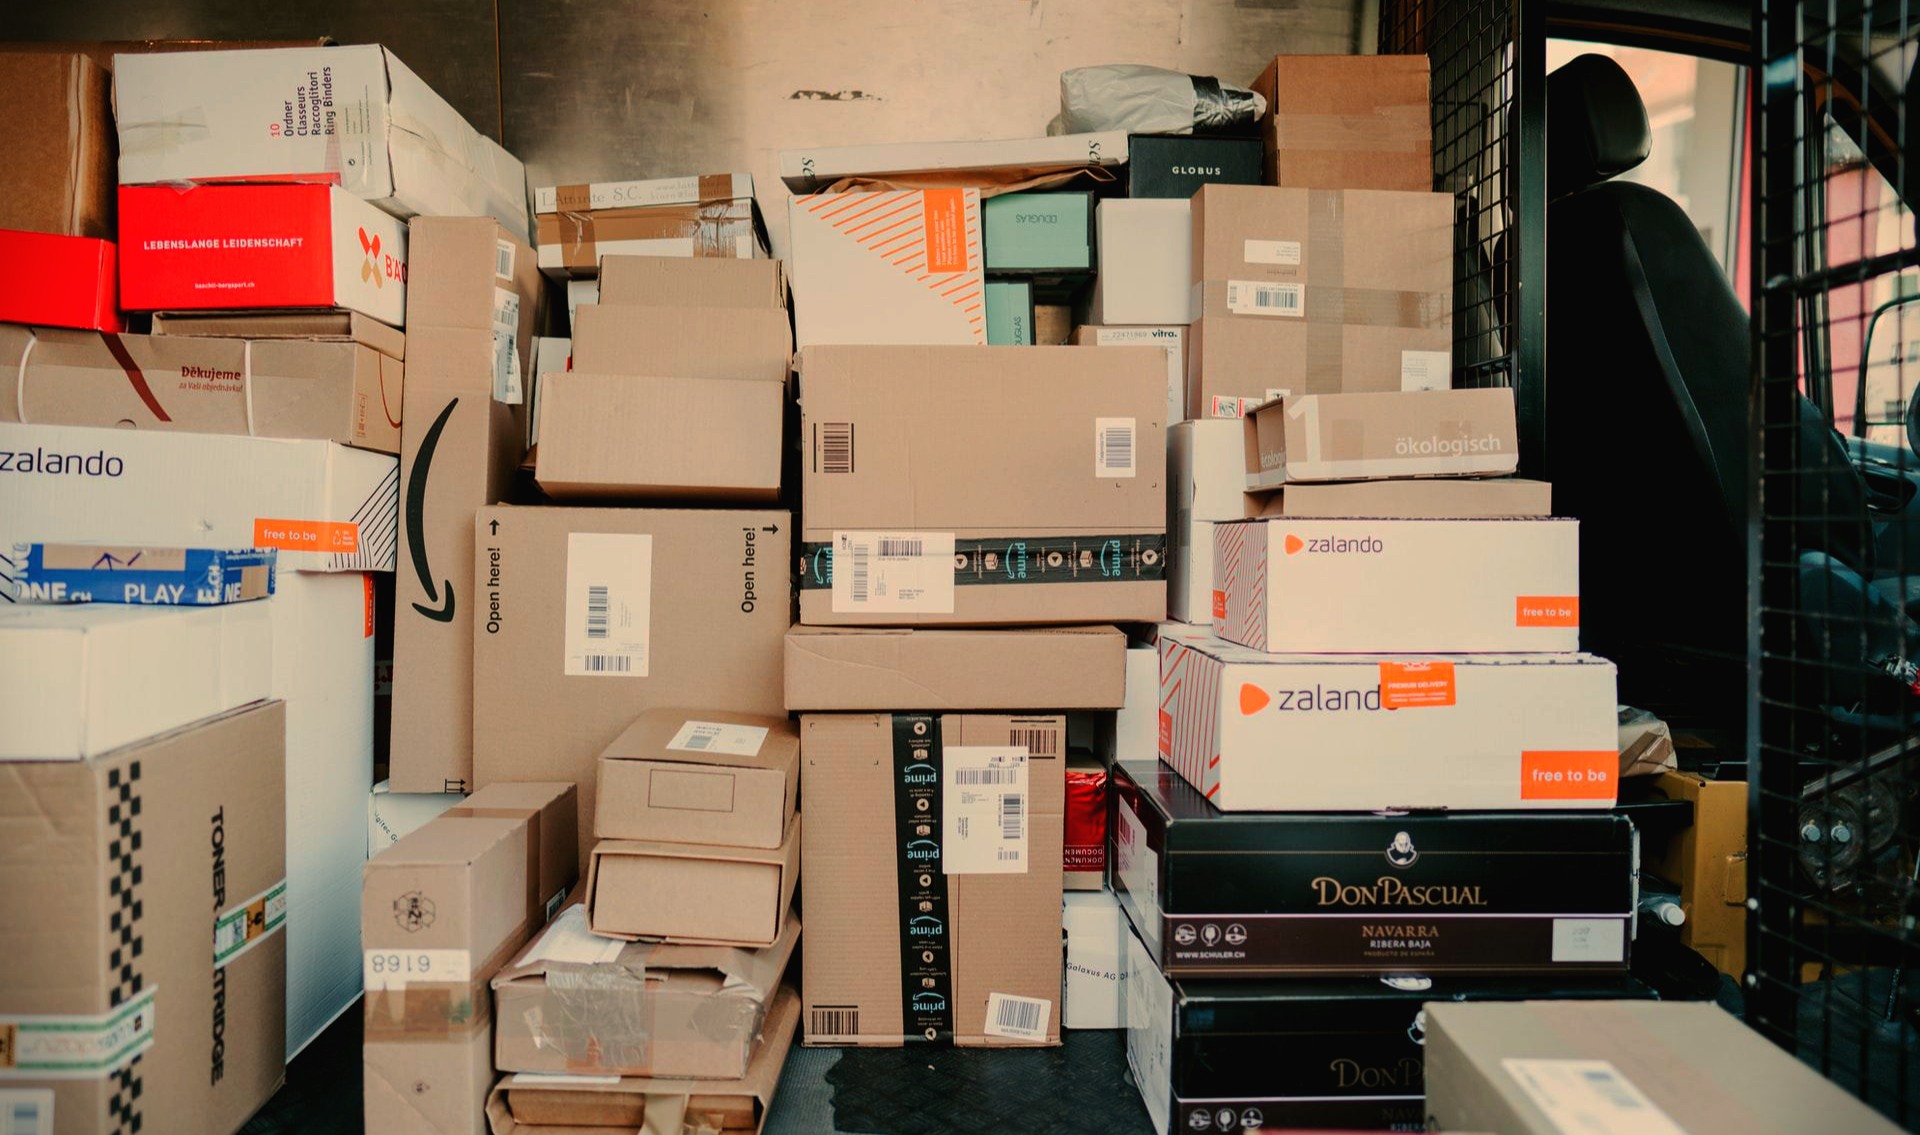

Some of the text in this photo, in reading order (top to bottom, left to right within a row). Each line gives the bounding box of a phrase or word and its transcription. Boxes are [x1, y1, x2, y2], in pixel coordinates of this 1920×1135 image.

[307, 72, 322, 136] Raccoglitori
[323, 66, 337, 135] Ring Binders
[297, 86, 308, 136] Classeurs
[283, 101, 294, 137] Ordner
[270, 123, 280, 137] 10
[1171, 166, 1222, 175] GLOBUS
[1015, 214, 1058, 224] DOUGLAS
[144, 238, 303, 250] LEBENSLANGE LEIDENSCHAFT
[1151, 328, 1178, 338] vitra.
[181, 366, 242, 381] Děkujeme
[1395, 433, 1501, 457] ökologisch
[0, 447, 124, 477] zalando
[264, 529, 317, 541] free to be
[1308, 535, 1383, 553] zalando
[1014, 542, 1029, 579] prime
[1109, 540, 1124, 577] prime
[741, 527, 758, 613] Open here!
[486, 547, 503, 634] Open here!
[1523, 607, 1572, 617] free to be
[1278, 684, 1398, 711] zaland
[904, 773, 937, 785] prime
[1532, 769, 1607, 781] free to be
[211, 806, 226, 911] TONER
[907, 848, 940, 861] prime
[910, 924, 943, 937] prime
[1362, 925, 1440, 938] NAVARRA
[1370, 939, 1431, 949] RIBERA BAJA
[1176, 951, 1246, 959] WWW.SCHULER.CH
[372, 954, 431, 973] 6168
[1066, 962, 1101, 977] Galaxus
[1104, 971, 1117, 981] AG
[913, 1001, 946, 1014] prime
